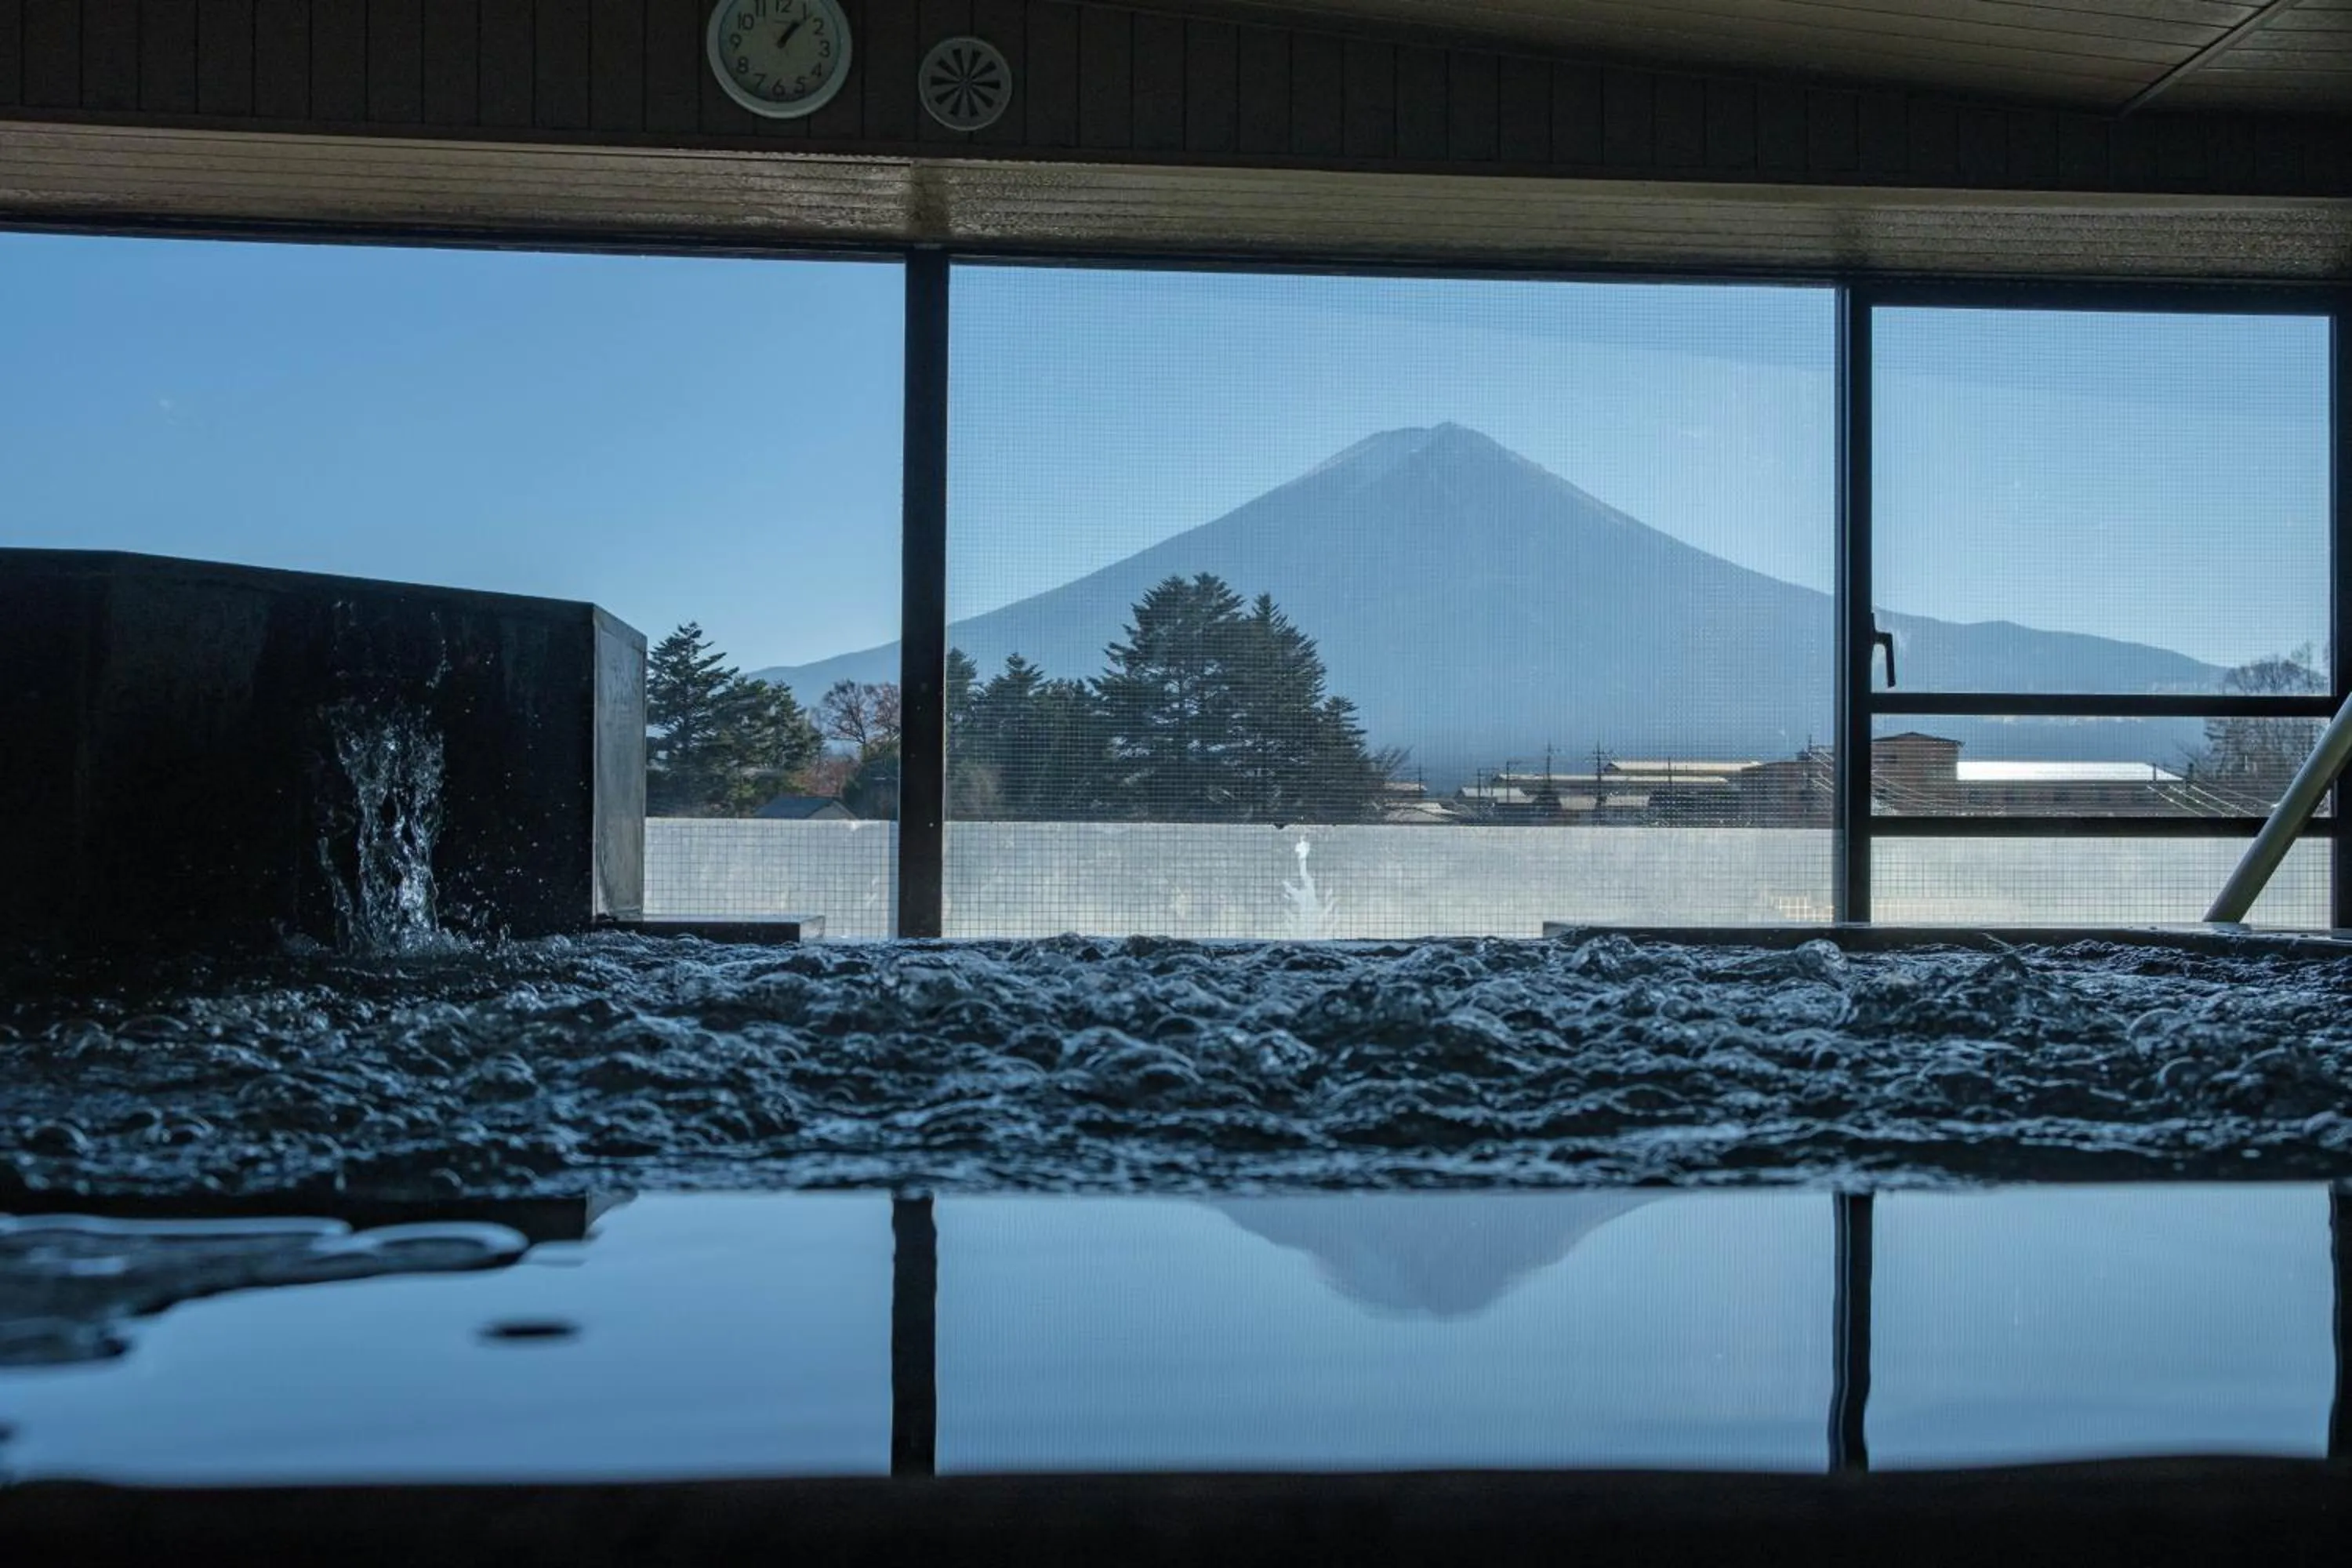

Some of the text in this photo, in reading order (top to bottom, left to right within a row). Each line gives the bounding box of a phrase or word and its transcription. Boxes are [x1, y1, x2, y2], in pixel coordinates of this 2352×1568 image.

[756, 0, 766, 17] 11
[775, 0, 792, 13] 12
[738, 12, 754, 31] 10
[813, 17, 825, 35] 2
[730, 33, 742, 53] 9
[818, 39, 831, 58] 3
[736, 56, 749, 74] 8
[811, 62, 822, 78] 4
[753, 73, 767, 93] 7
[771, 78, 786, 96] 6
[794, 76, 806, 93] 5
